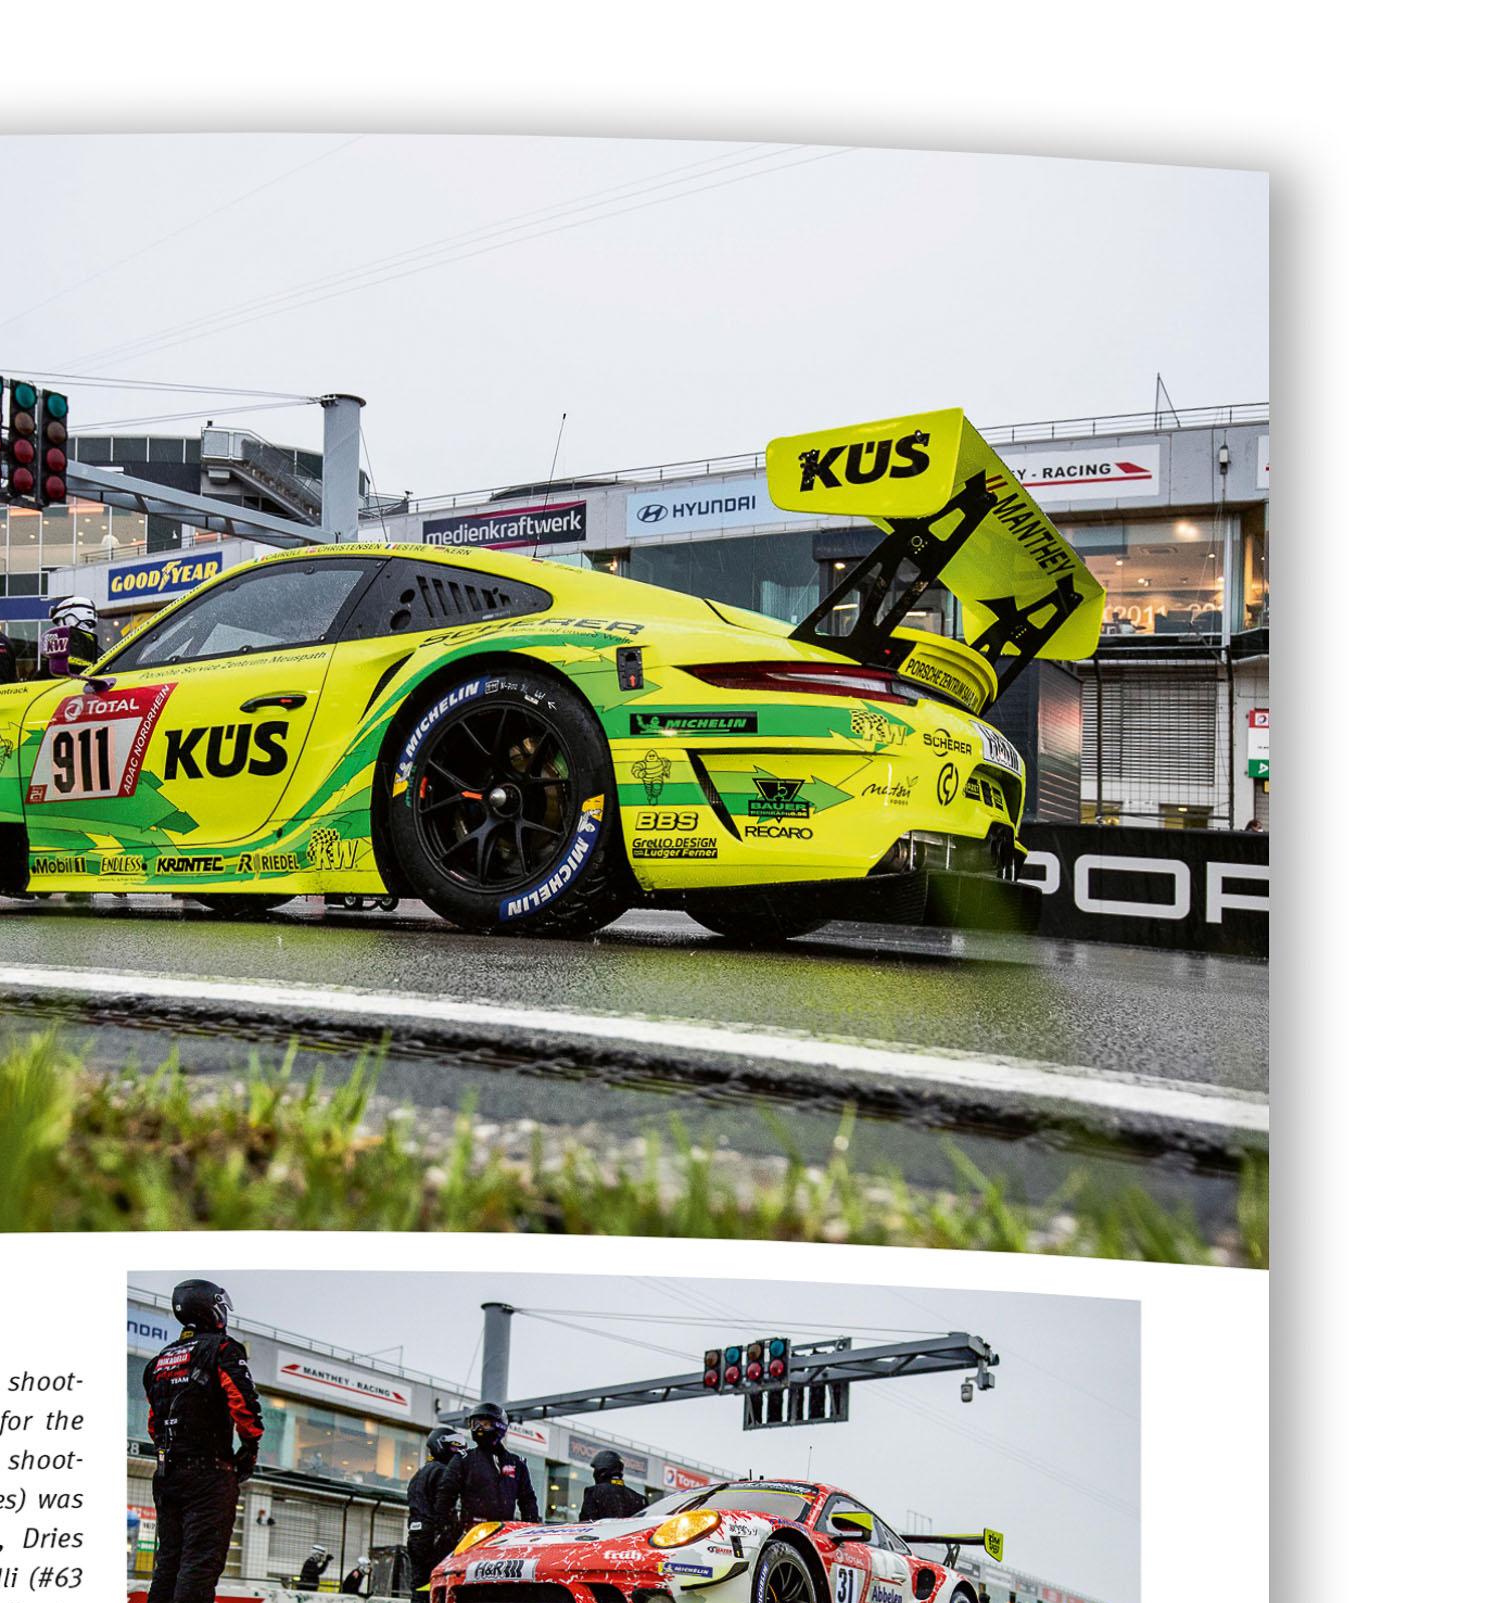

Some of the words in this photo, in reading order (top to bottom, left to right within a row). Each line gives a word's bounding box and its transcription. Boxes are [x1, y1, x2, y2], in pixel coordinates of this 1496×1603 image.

[799, 431, 931, 492] KÜS
[1042, 463, 1112, 478] RACING
[672, 495, 757, 518] HYUNDAI
[426, 509, 582, 546] medienkraftwerk
[991, 492, 1077, 576] MANTHEY
[317, 542, 382, 553] CHRISTENSEN
[396, 543, 427, 553] ESTRE
[444, 545, 473, 556] KERN
[111, 559, 221, 593] GOODYEAR
[906, 657, 943, 685] PORSCHE
[87, 697, 140, 714] TOTAL
[406, 680, 481, 759] MICHELIN
[666, 718, 748, 729] MICHELIN
[123, 751, 142, 795] ADAC
[134, 684, 170, 757] NORDRHEIN
[164, 720, 289, 781] KÜS
[922, 732, 972, 756] SCHERER
[52, 724, 109, 793] 911
[750, 801, 808, 811] BAUER
[635, 812, 699, 831] BBS
[745, 825, 814, 840] RECARO
[157, 856, 224, 872] KRONTEC
[262, 854, 300, 871] RIEDEL
[644, 848, 679, 858] Ludger
[681, 848, 717, 857] Ferner
[101, 856, 142, 875] ENDLESS
[507, 836, 590, 919] MICHELIN
[7, 1370, 84, 1392] shoot-
[171, 1376, 189, 1385] TEAM
[303, 1366, 350, 1385] MANTHEY
[356, 1381, 391, 1398] RACING
